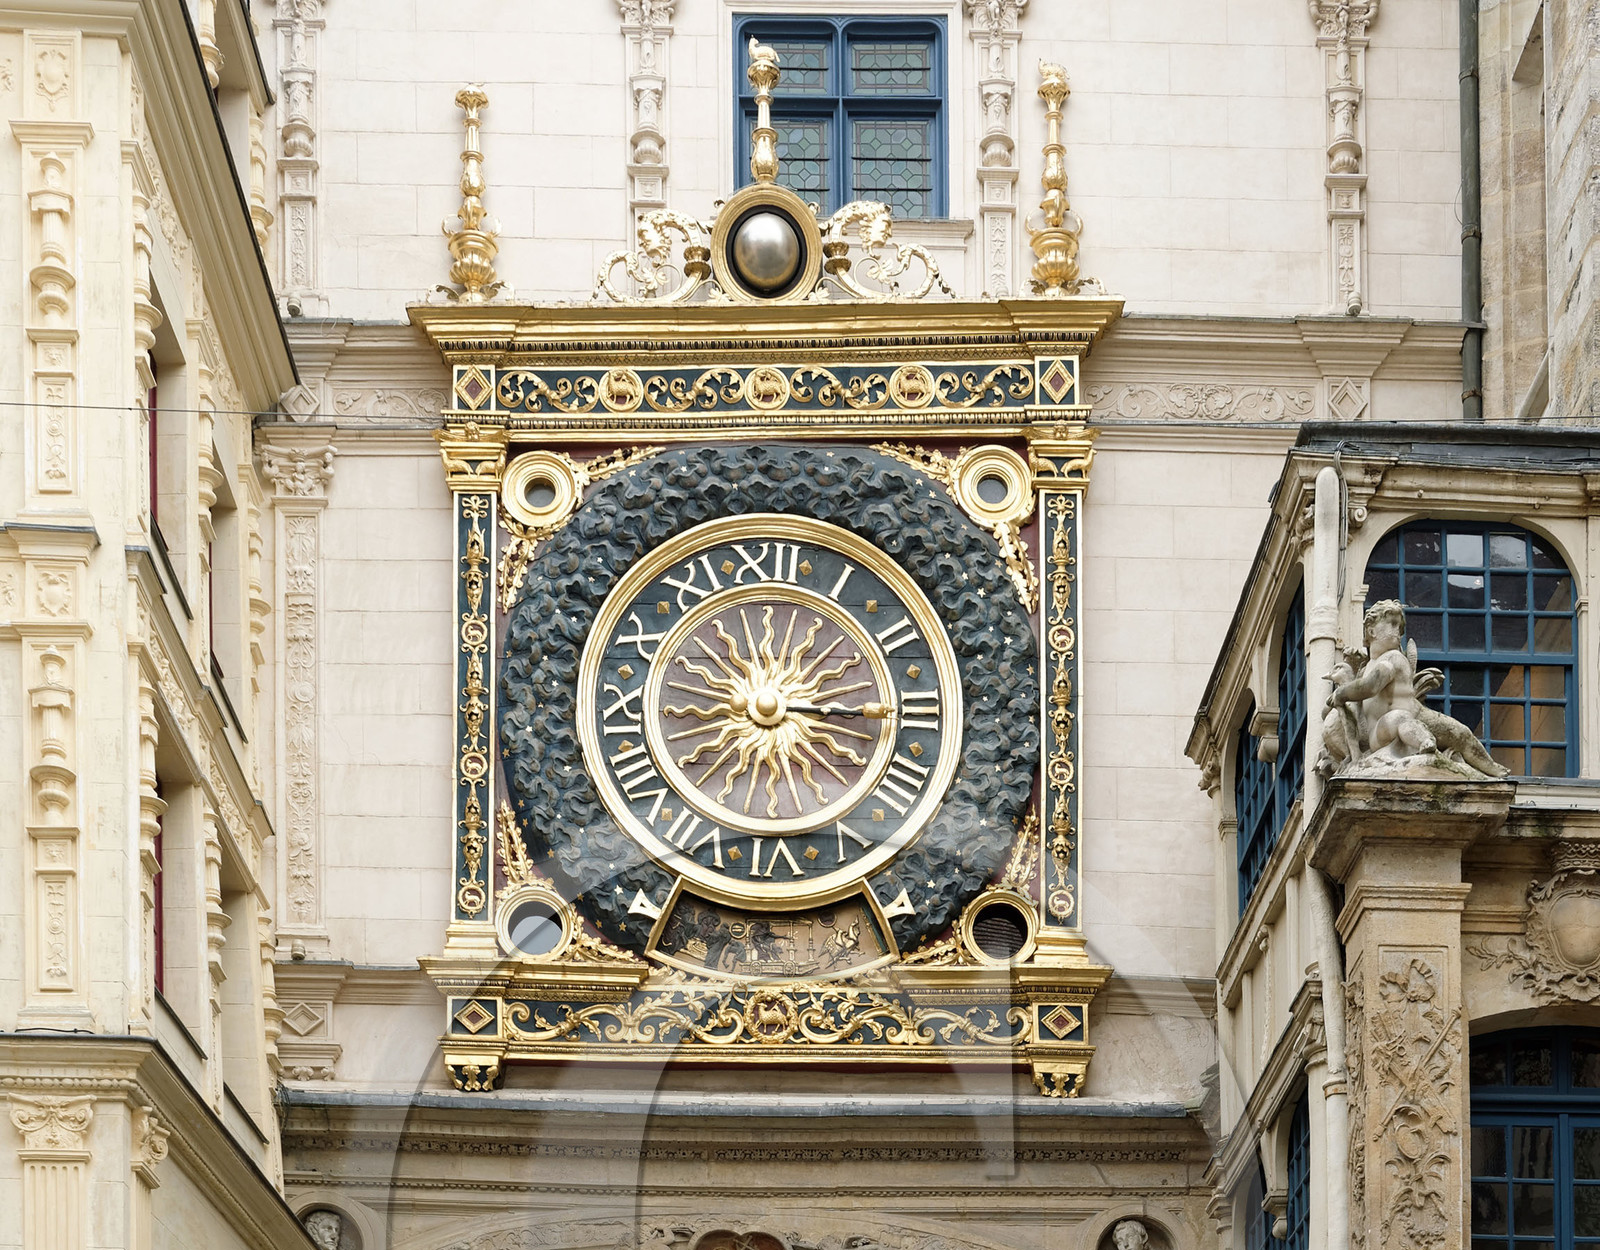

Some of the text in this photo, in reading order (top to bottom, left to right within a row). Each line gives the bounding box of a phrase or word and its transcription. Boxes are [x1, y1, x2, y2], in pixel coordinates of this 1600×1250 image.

[660, 553, 725, 613] XI
[732, 542, 801, 585] XII
[827, 563, 856, 601] I
[614, 611, 668, 663] X
[873, 614, 921, 656] II
[603, 682, 643, 737] IX
[900, 689, 940, 731] III
[661, 807, 726, 870] VII
[748, 837, 805, 877] VI
[833, 820, 873, 863] V
